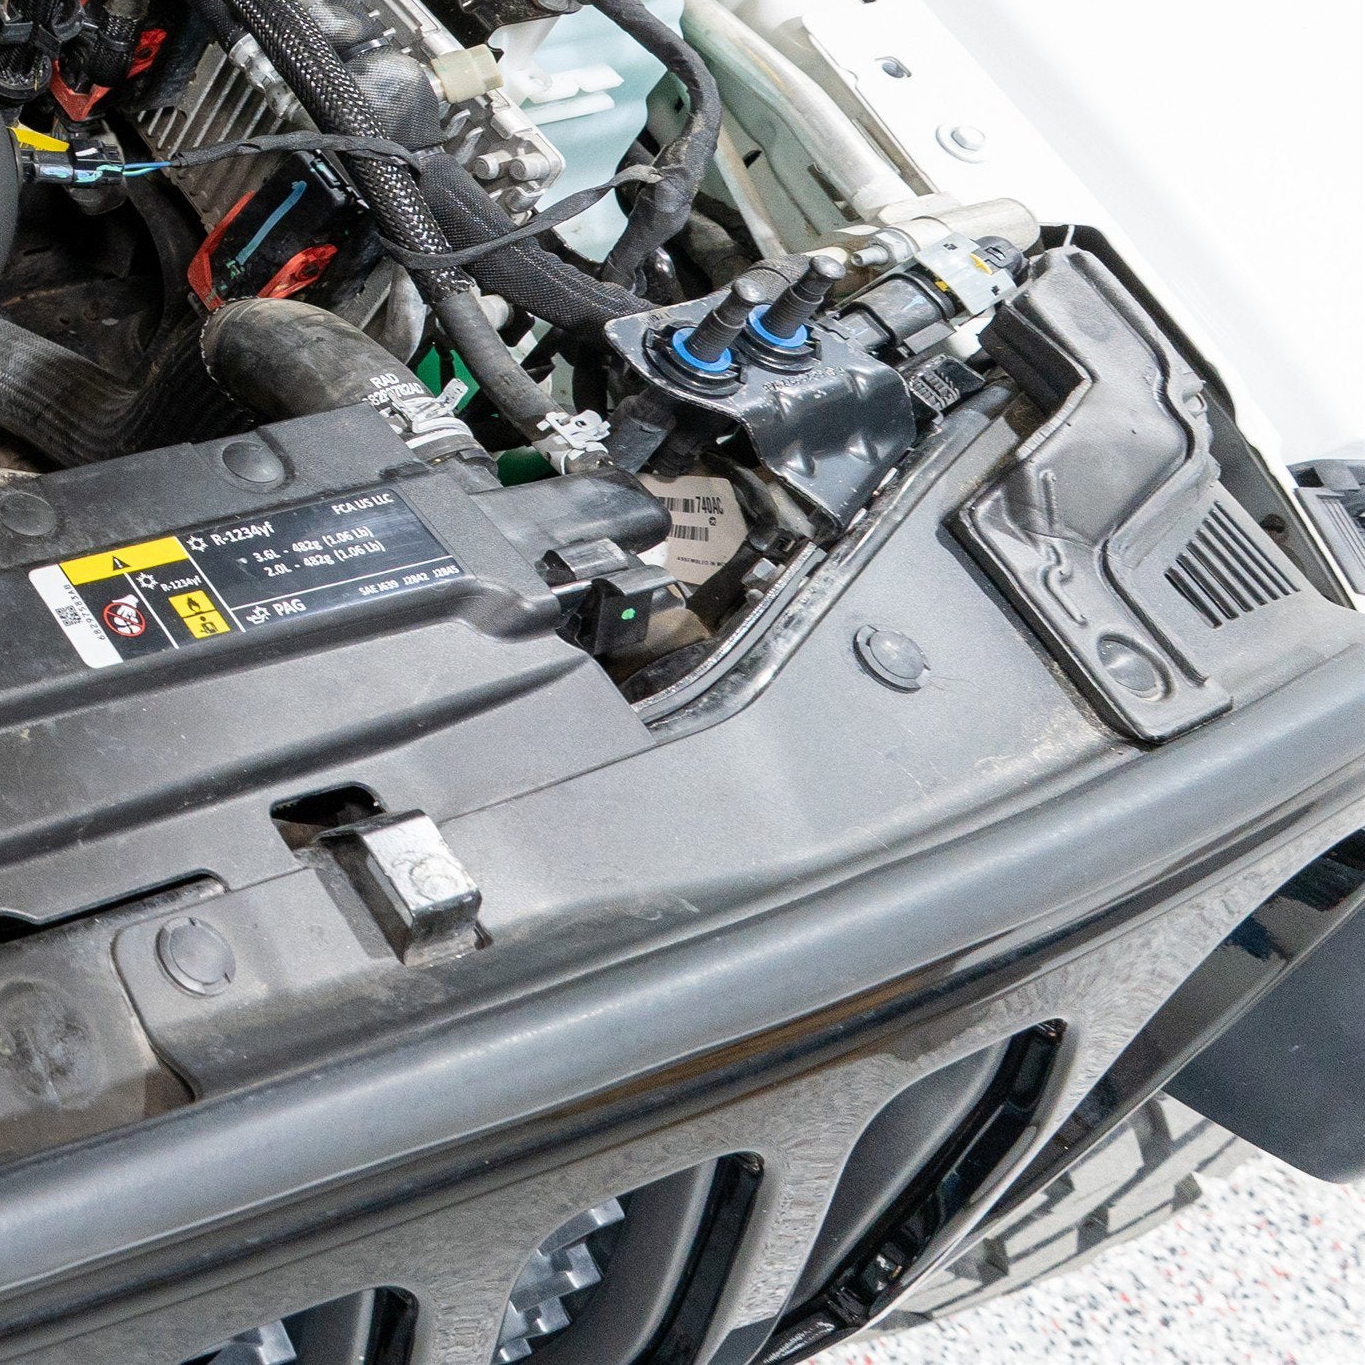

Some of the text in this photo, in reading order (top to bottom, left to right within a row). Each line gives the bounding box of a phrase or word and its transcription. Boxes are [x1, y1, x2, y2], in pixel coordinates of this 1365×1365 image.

[369, 373, 400, 389] RAD
[331, 493, 395, 516] FCA US LLC
[695, 496, 725, 515] 740AC
[209, 521, 276, 547] R-1234yf
[253, 548, 281, 564] 3.6L
[291, 539, 323, 556] 482g
[322, 531, 354, 549] (1.06
[354, 525, 375, 541] Lb)
[264, 562, 293, 578] 2.0L
[303, 553, 335, 569] 482g
[334, 546, 365, 563] (1.06
[365, 539, 386, 554] Lb)
[160, 575, 202, 592] R-1234yf
[358, 565, 461, 596] SAE J639 J2842 J2845
[272, 598, 307, 617] PAG
